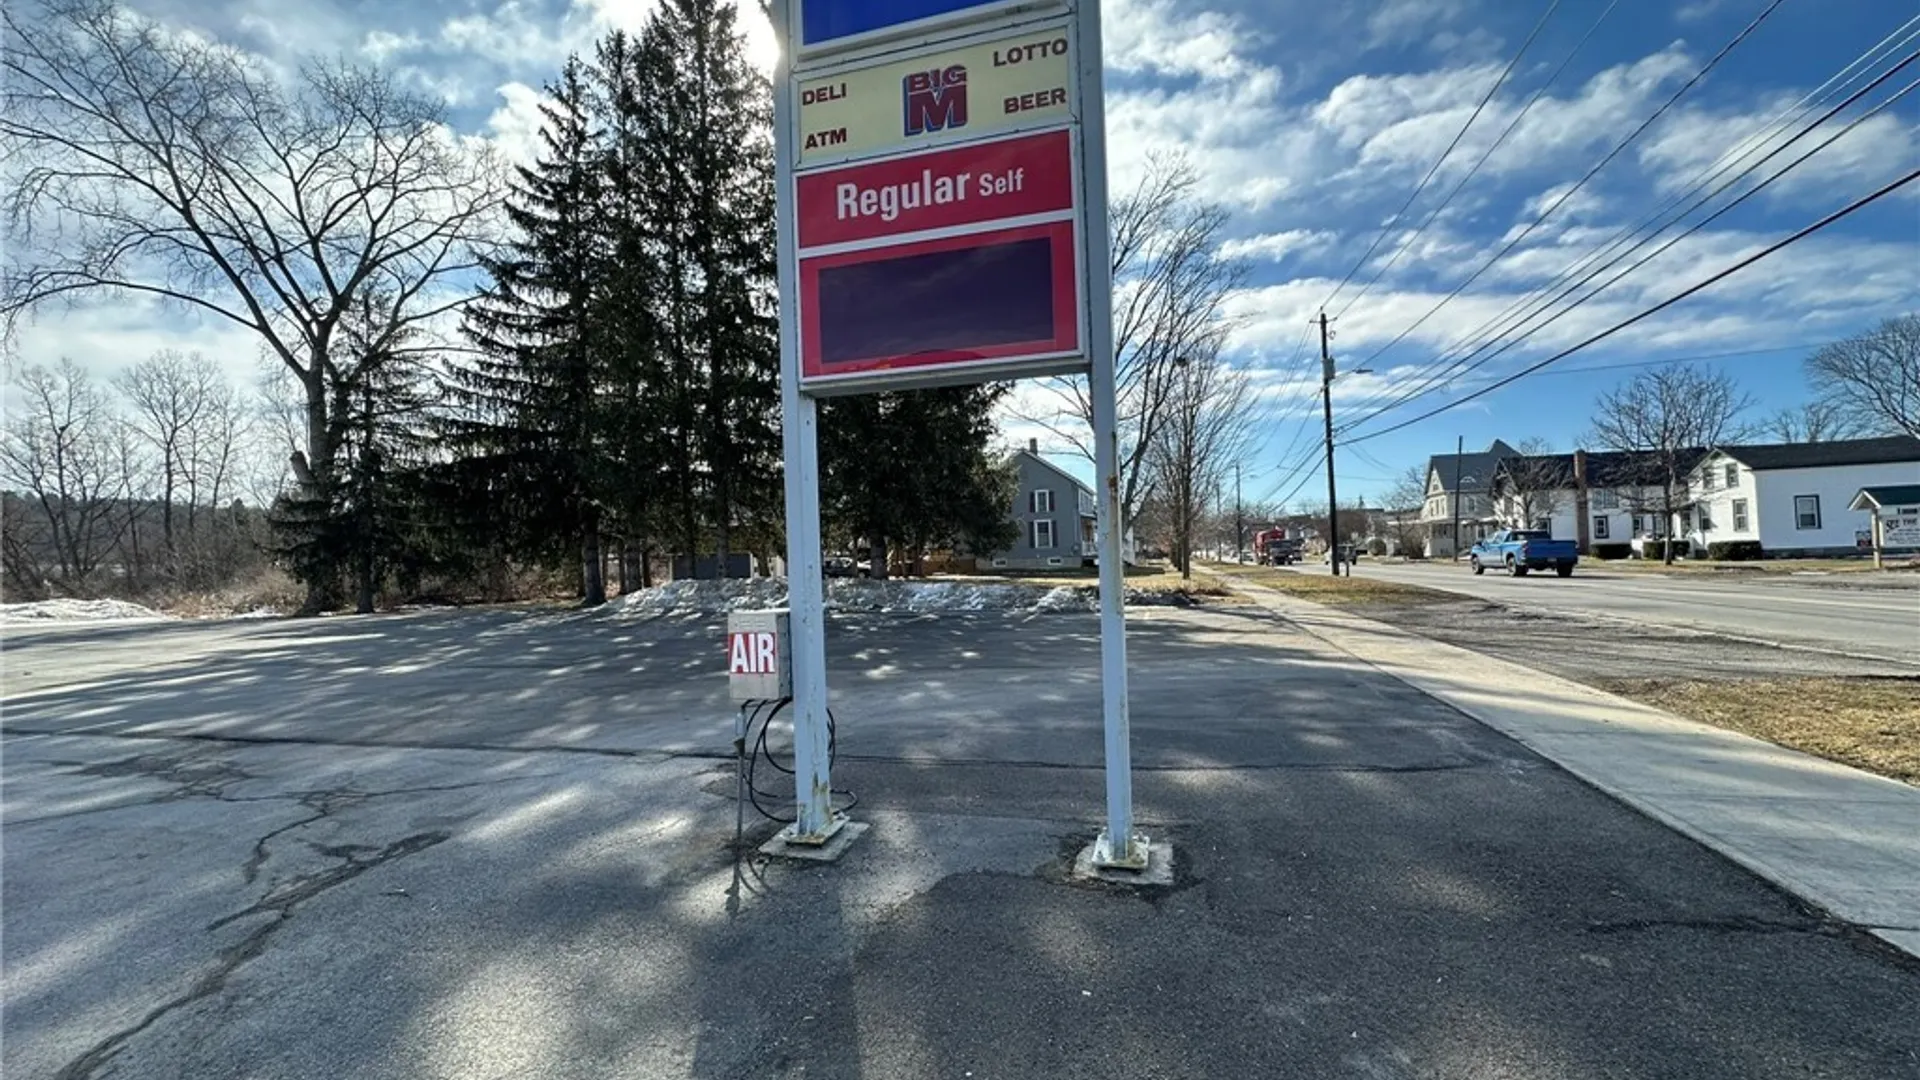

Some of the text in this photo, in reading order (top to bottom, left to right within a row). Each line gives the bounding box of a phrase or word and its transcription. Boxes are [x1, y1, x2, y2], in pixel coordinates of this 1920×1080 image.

[993, 38, 1068, 67] LOTTO
[904, 65, 967, 91] BIG
[802, 83, 847, 106] DELI
[1004, 87, 1067, 114] BEER
[903, 85, 968, 136] M
[805, 128, 847, 149] ATM
[837, 168, 1025, 221] Regular Self
[730, 633, 775, 673] AIR
